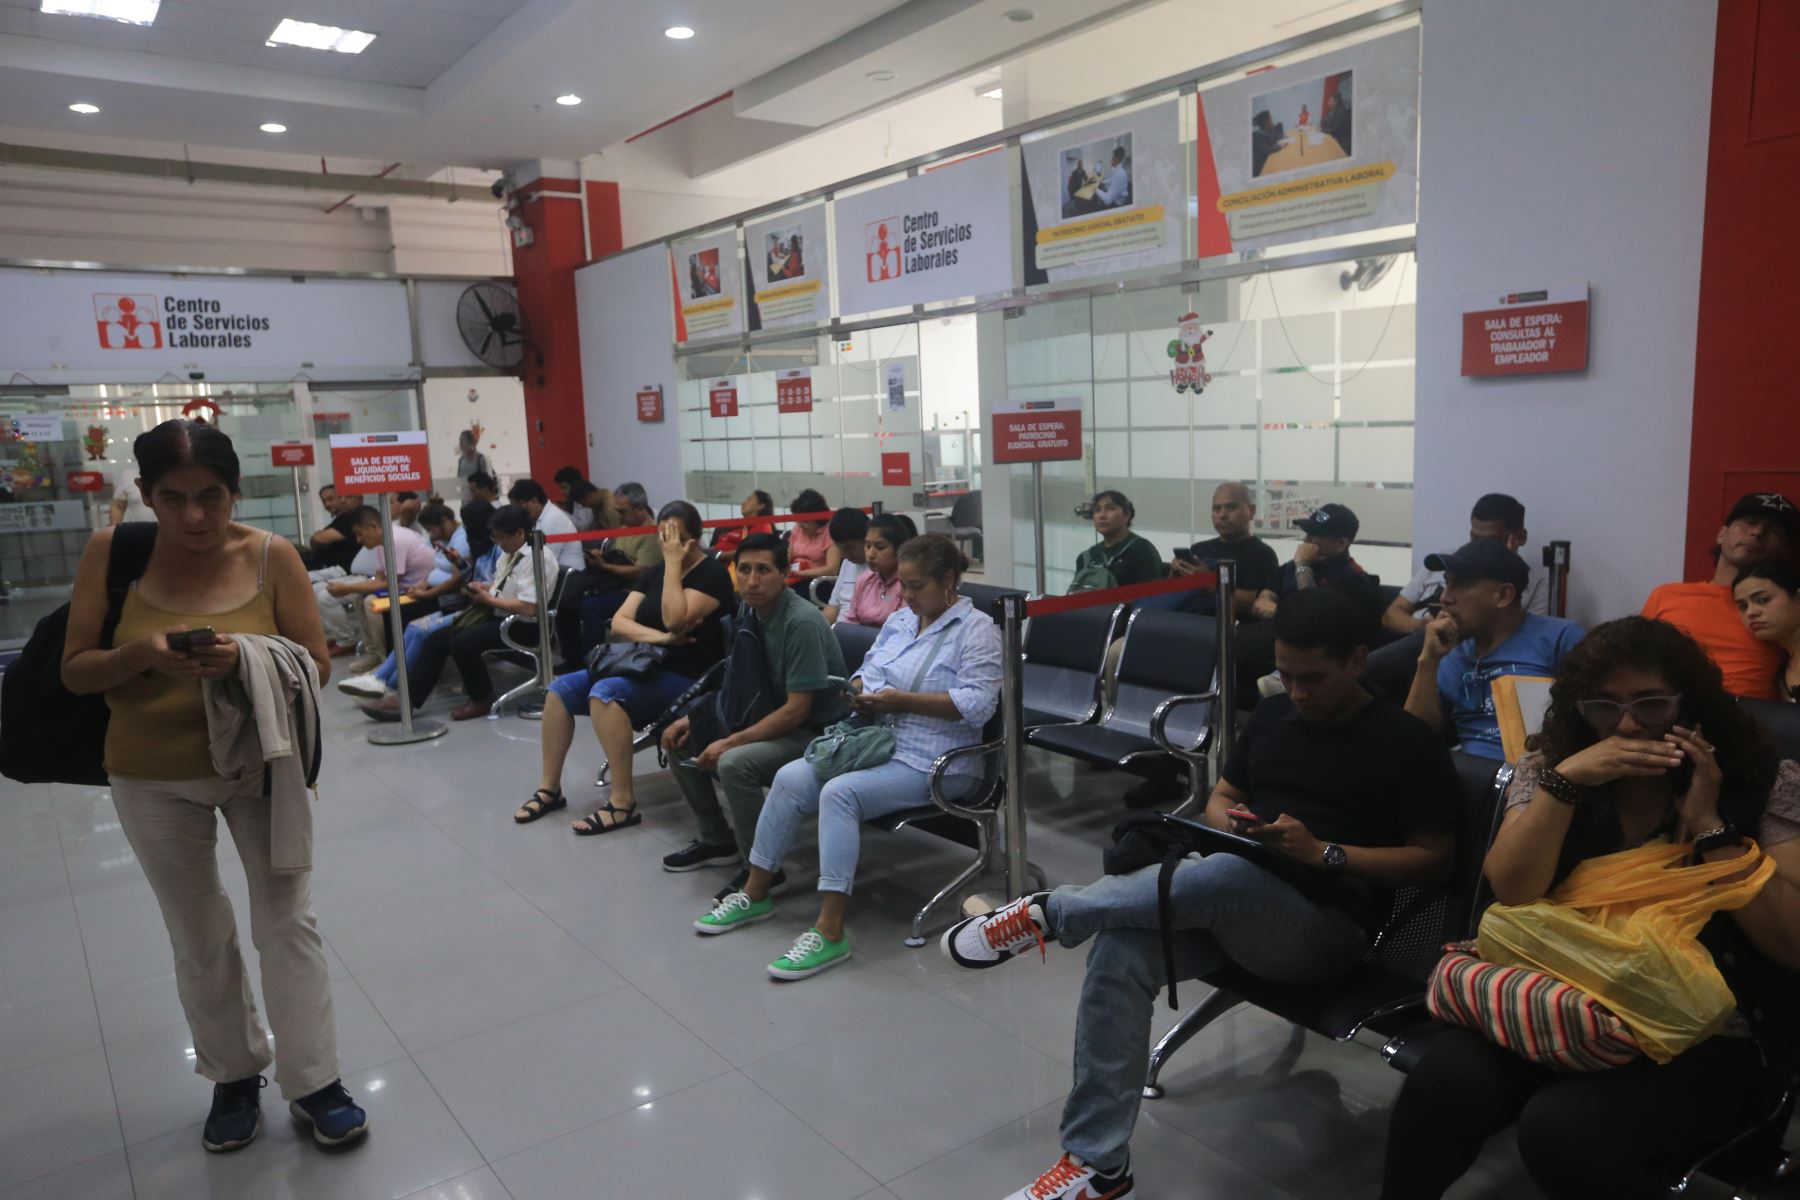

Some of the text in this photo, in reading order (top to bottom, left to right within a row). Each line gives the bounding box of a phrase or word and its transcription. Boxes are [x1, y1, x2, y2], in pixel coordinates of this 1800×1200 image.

[1223, 168, 1385, 208] CONCILIACIÓN ADMINISTRATIVA LABORAL
[904, 211, 938, 234] Centro
[904, 223, 972, 253] de Servicios
[905, 248, 958, 274] Laborales
[164, 296, 220, 313] Centro
[166, 314, 270, 331] de Servicios
[1485, 313, 1562, 330] SALA DE ESPERA:
[169, 332, 252, 348] Laborales
[1490, 326, 1556, 341] CONSULTAS AL
[1490, 338, 1556, 353] TRABAJADOR Y
[1495, 351, 1549, 365] EMPLEADOR
[1009, 424, 1026, 432] SALA
[1027, 423, 1036, 431] DE
[1018, 431, 1056, 440] PATROCINIO
[1008, 439, 1068, 449] JUDICIAL GRATUITO
[351, 455, 411, 466] SALA DE ESPERA:
[354, 463, 410, 474] LIQUIDACIÓN DE
[345, 472, 420, 484] BENEFICIOS SOCIALES
